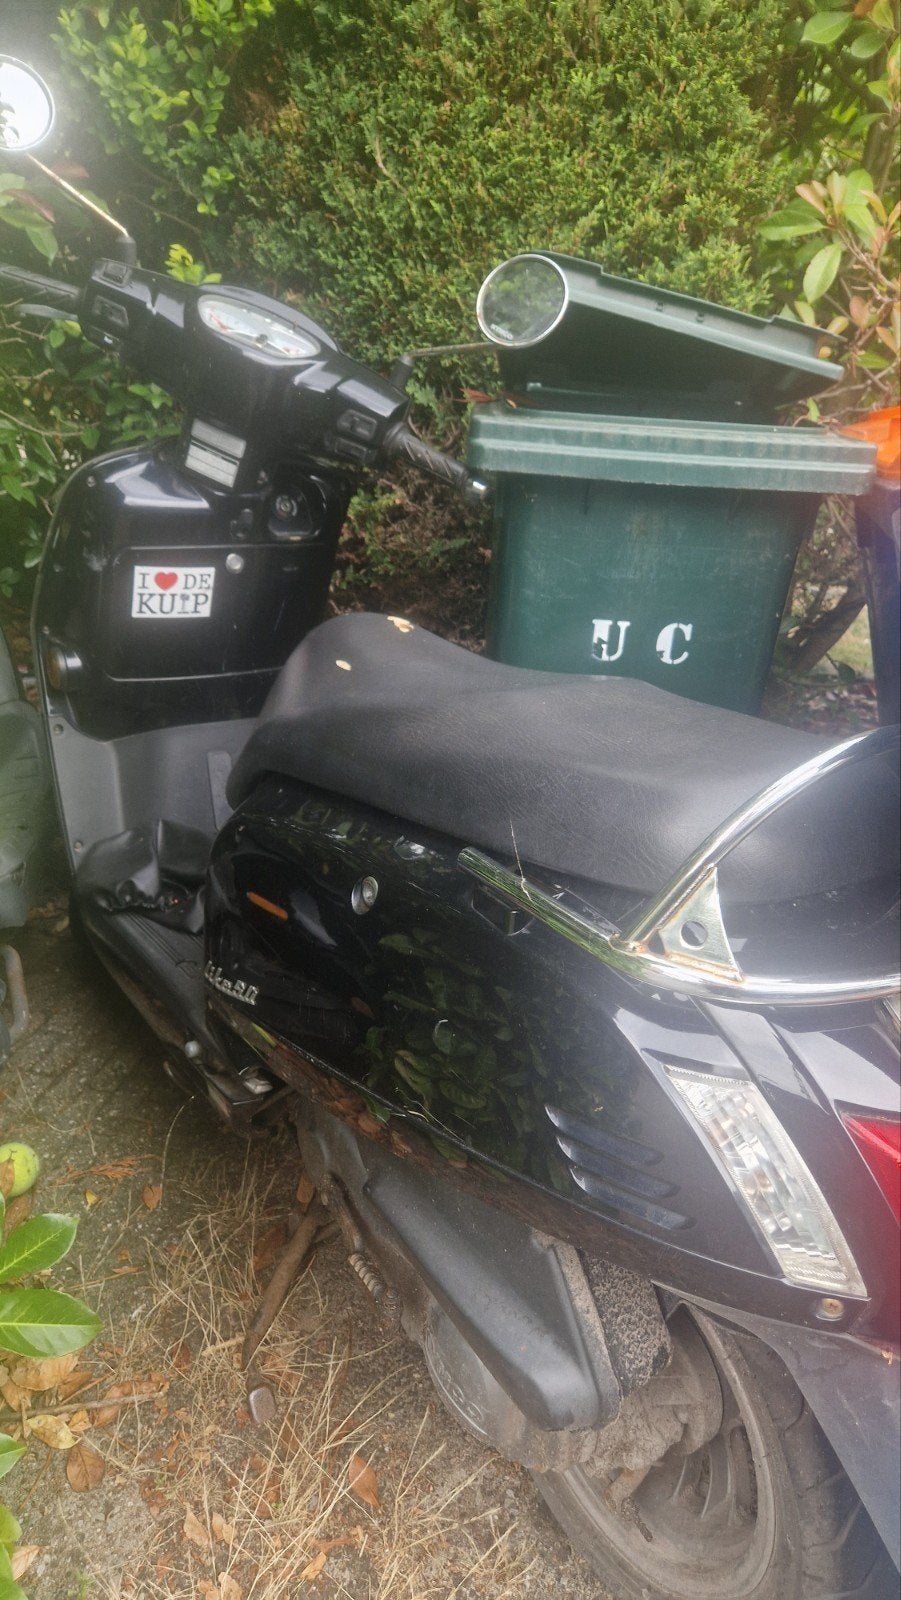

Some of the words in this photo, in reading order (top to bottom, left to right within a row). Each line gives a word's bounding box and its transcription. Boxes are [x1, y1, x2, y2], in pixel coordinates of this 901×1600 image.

[138, 573, 150, 590] I
[183, 573, 212, 590] DE
[136, 592, 209, 615] KUIP
[655, 622, 693, 665] C
